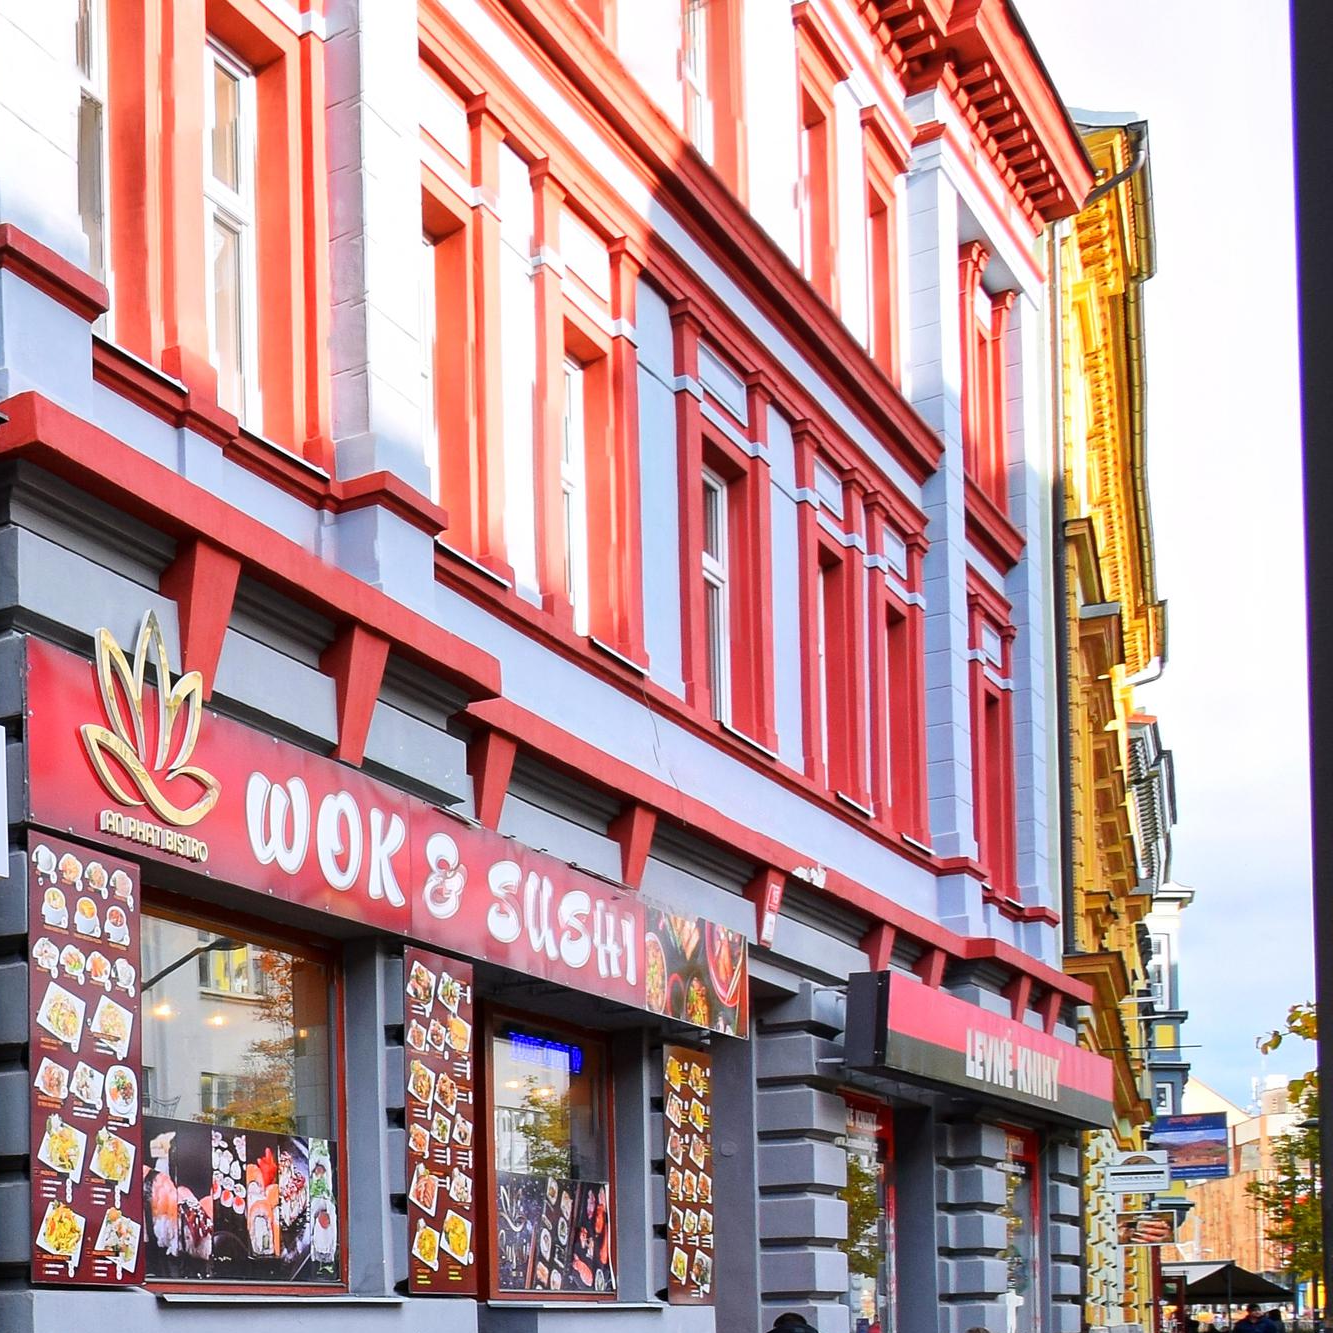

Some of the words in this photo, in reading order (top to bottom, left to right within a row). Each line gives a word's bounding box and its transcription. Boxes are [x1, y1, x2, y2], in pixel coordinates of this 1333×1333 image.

[162, 829, 209, 863] BISTRO
[245, 770, 407, 909] WOK
[421, 831, 469, 920] &
[486, 859, 639, 987] SUSHI
[965, 1028, 1013, 1089] LEVNÉ
[1016, 1045, 1061, 1102] KNIHY
